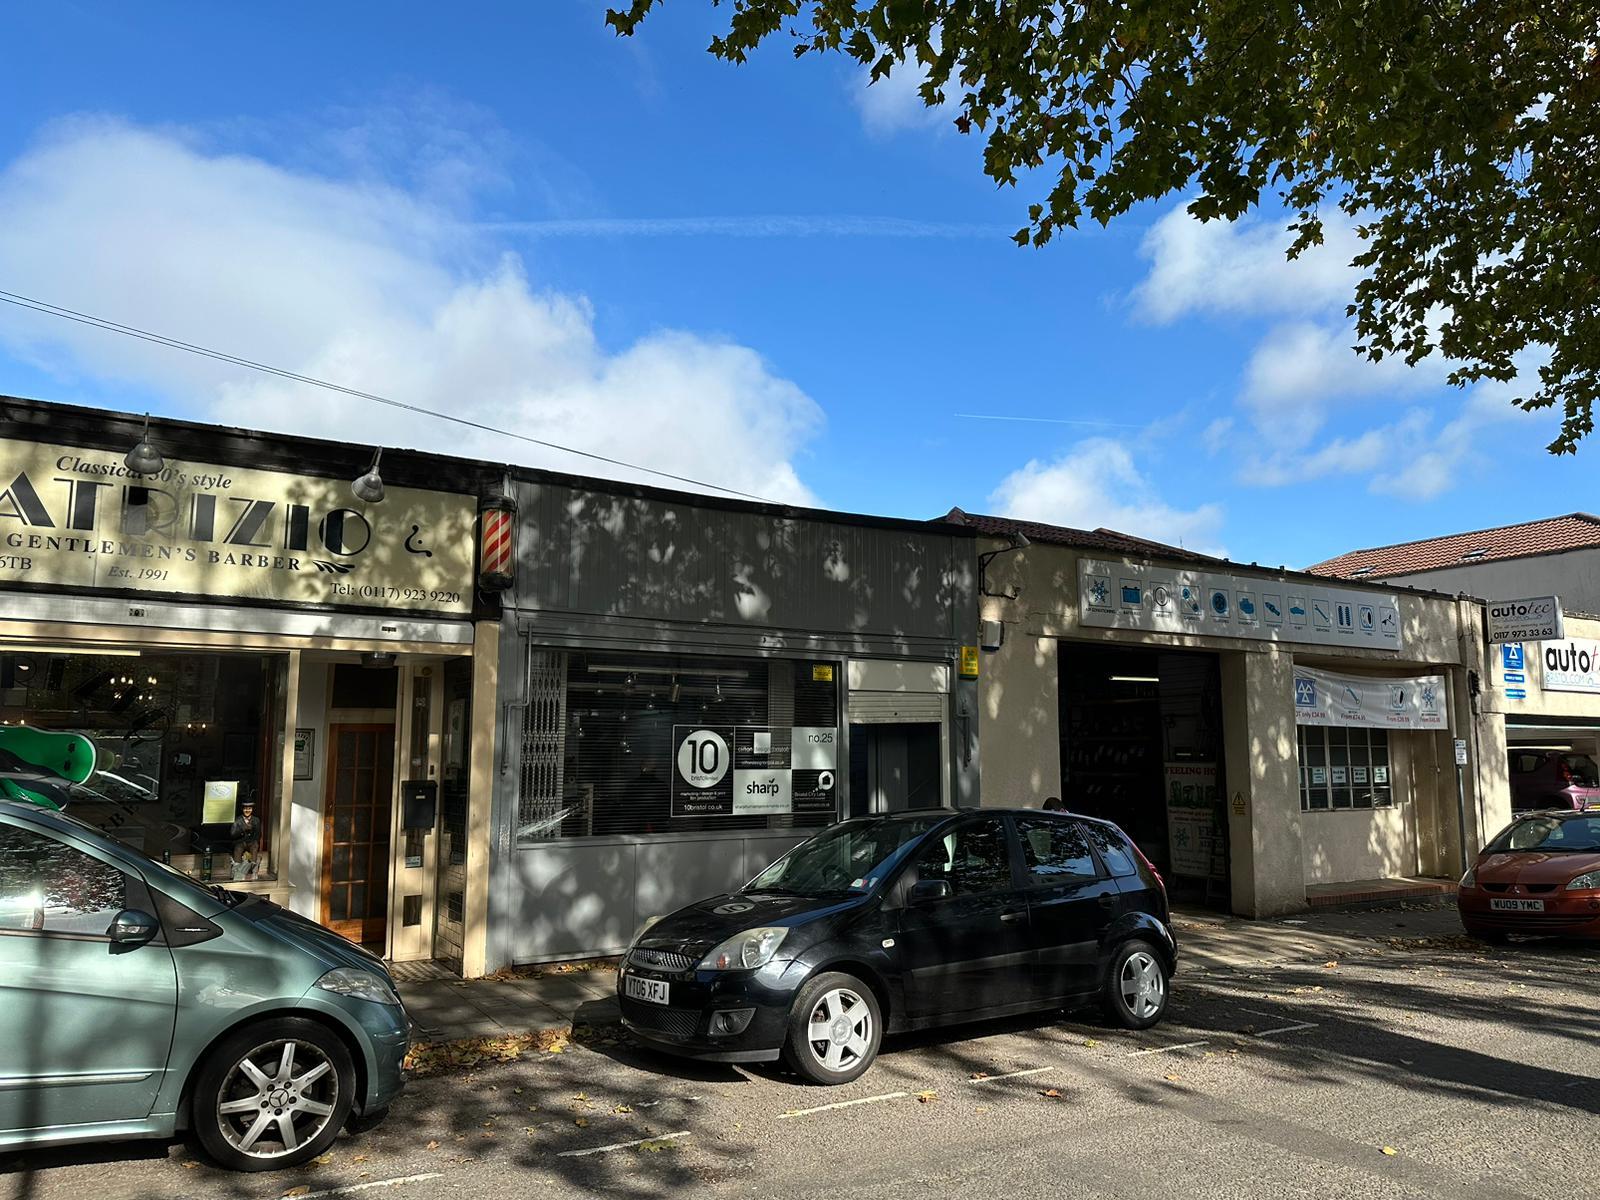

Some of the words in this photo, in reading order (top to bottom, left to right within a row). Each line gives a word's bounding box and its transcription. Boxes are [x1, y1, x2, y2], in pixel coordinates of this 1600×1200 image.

[56, 455, 144, 479] Classica
[191, 474, 232, 490] style
[6, 533, 196, 562] GENTLEMEN'S
[207, 550, 300, 571] BARBER
[107, 566, 132, 579] Est.
[138, 568, 168, 581] 1991
[330, 582, 355, 596] Tel:
[359, 584, 400, 600] (0117)
[403, 589, 426, 600] 923
[430, 590, 460, 604] 9220
[1493, 631, 1509, 639] 0117
[1512, 630, 1527, 638] 973
[1529, 629, 1540, 637] 33
[1542, 627, 1553, 636] 63
[808, 733, 833, 744] no.25
[687, 739, 719, 775] 10
[746, 781, 779, 797] sharp
[1520, 901, 1540, 910] YMC
[648, 982, 666, 1000] XFJ
